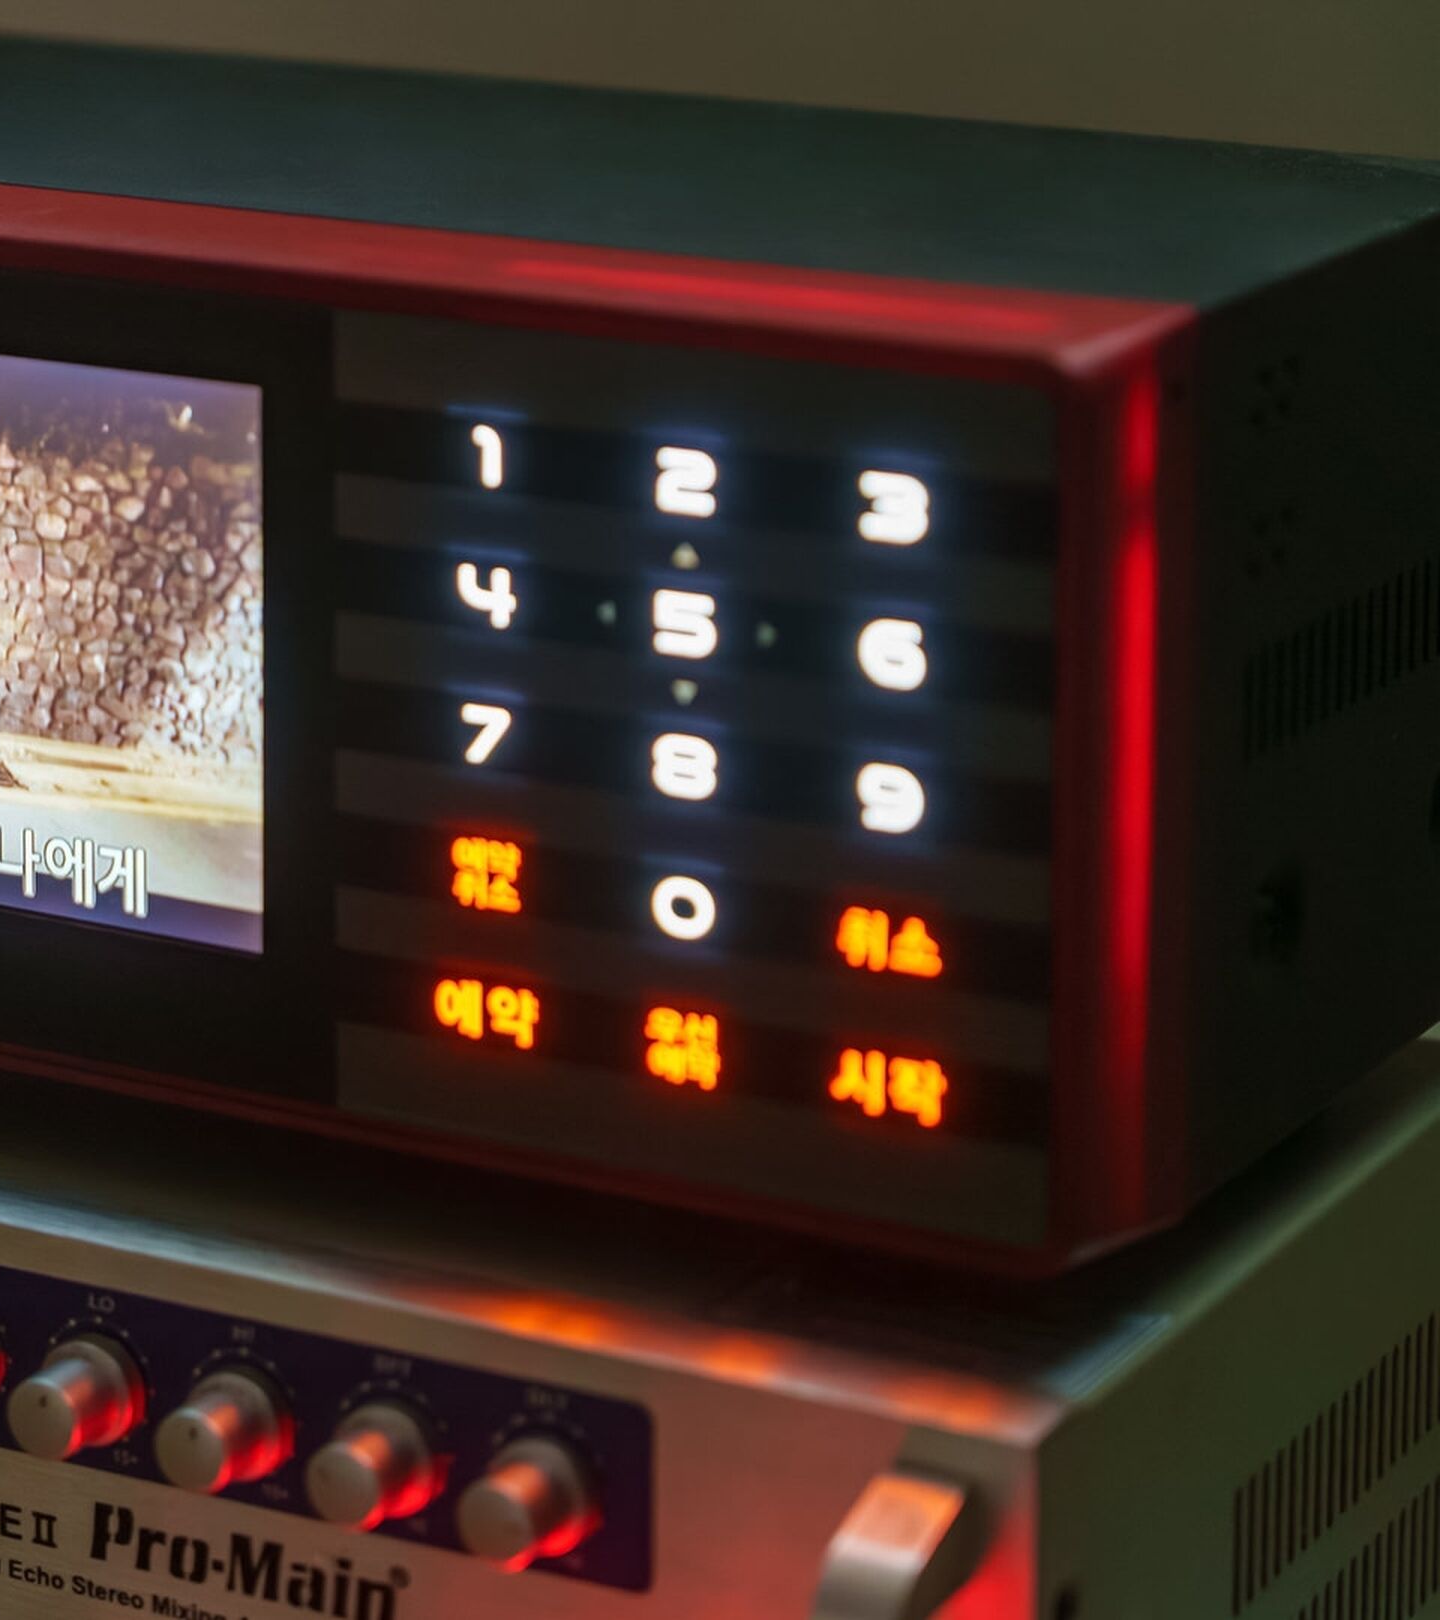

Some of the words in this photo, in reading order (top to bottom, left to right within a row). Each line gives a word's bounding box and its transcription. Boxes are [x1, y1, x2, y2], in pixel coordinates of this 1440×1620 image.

[472, 425, 502, 488] 1
[656, 447, 716, 517] 2
[859, 471, 928, 544] 3
[457, 563, 516, 628] 4
[653, 590, 717, 658] 5
[858, 619, 926, 690] 6
[462, 703, 511, 763] 7
[652, 734, 717, 800] 8
[857, 763, 924, 833] 9
[433, 979, 540, 1049] 예약
[828, 1048, 948, 1128] 시작
[8, 1559, 65, 1590] Echo
[71, 1574, 145, 1610] Stereo
[151, 1593, 227, 1620] Mixin
